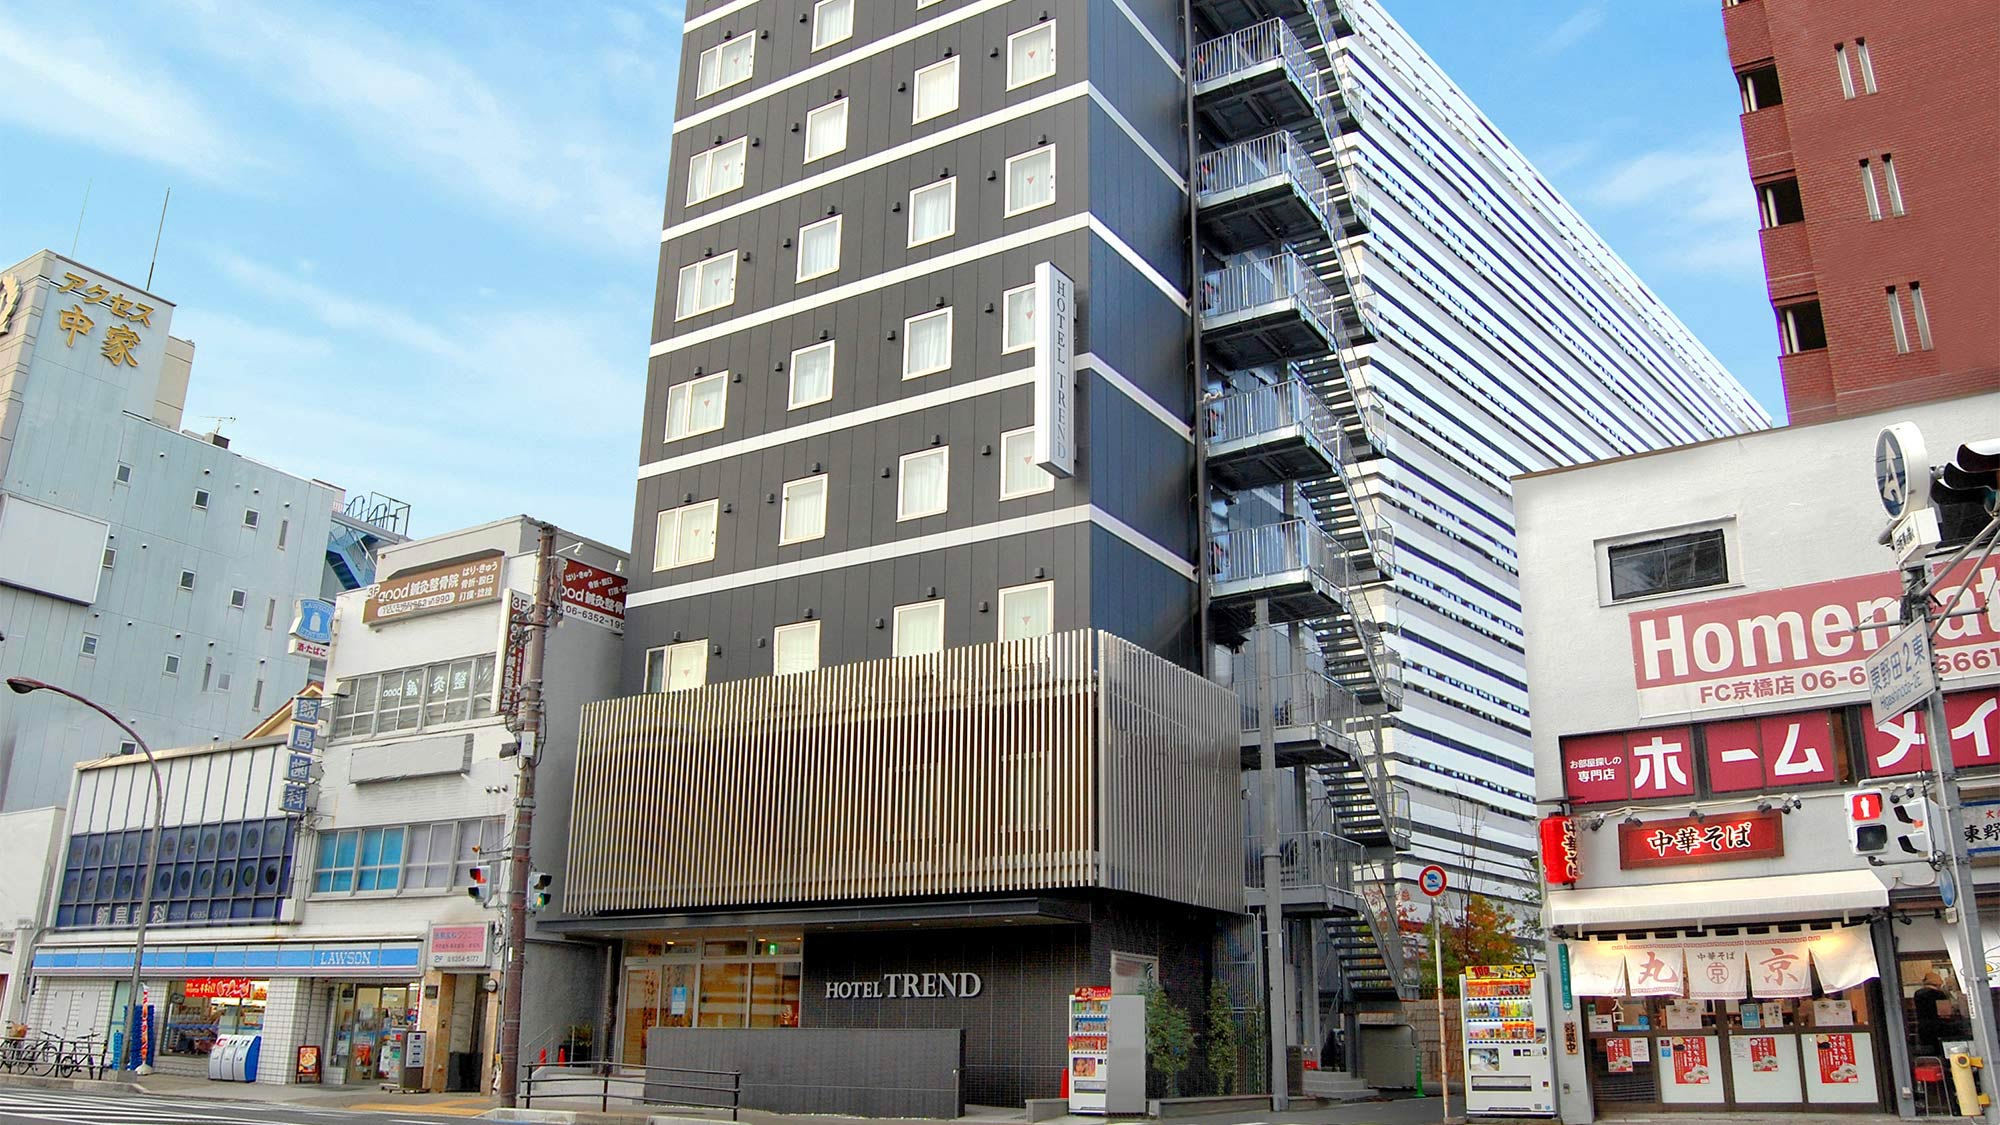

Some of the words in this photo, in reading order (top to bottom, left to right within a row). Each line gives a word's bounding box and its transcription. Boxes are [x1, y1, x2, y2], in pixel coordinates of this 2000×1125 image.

[58, 272, 154, 327] アクセス
[59, 304, 141, 367] 中家
[1056, 279, 1066, 364] HOTEL
[1056, 371, 1067, 459] TREND
[513, 597, 528, 608] 3F
[1700, 675, 1795, 704] FC京橋店
[1577, 768, 1615, 782] 専門店
[1650, 822, 1752, 856] 中華そば
[320, 951, 371, 965] LAWSON
[1638, 951, 1677, 984] 丸
[1697, 951, 1736, 961] 中華そば
[1760, 947, 1800, 986] 京
[825, 981, 882, 998] HOTEL
[884, 972, 982, 998] TREND
